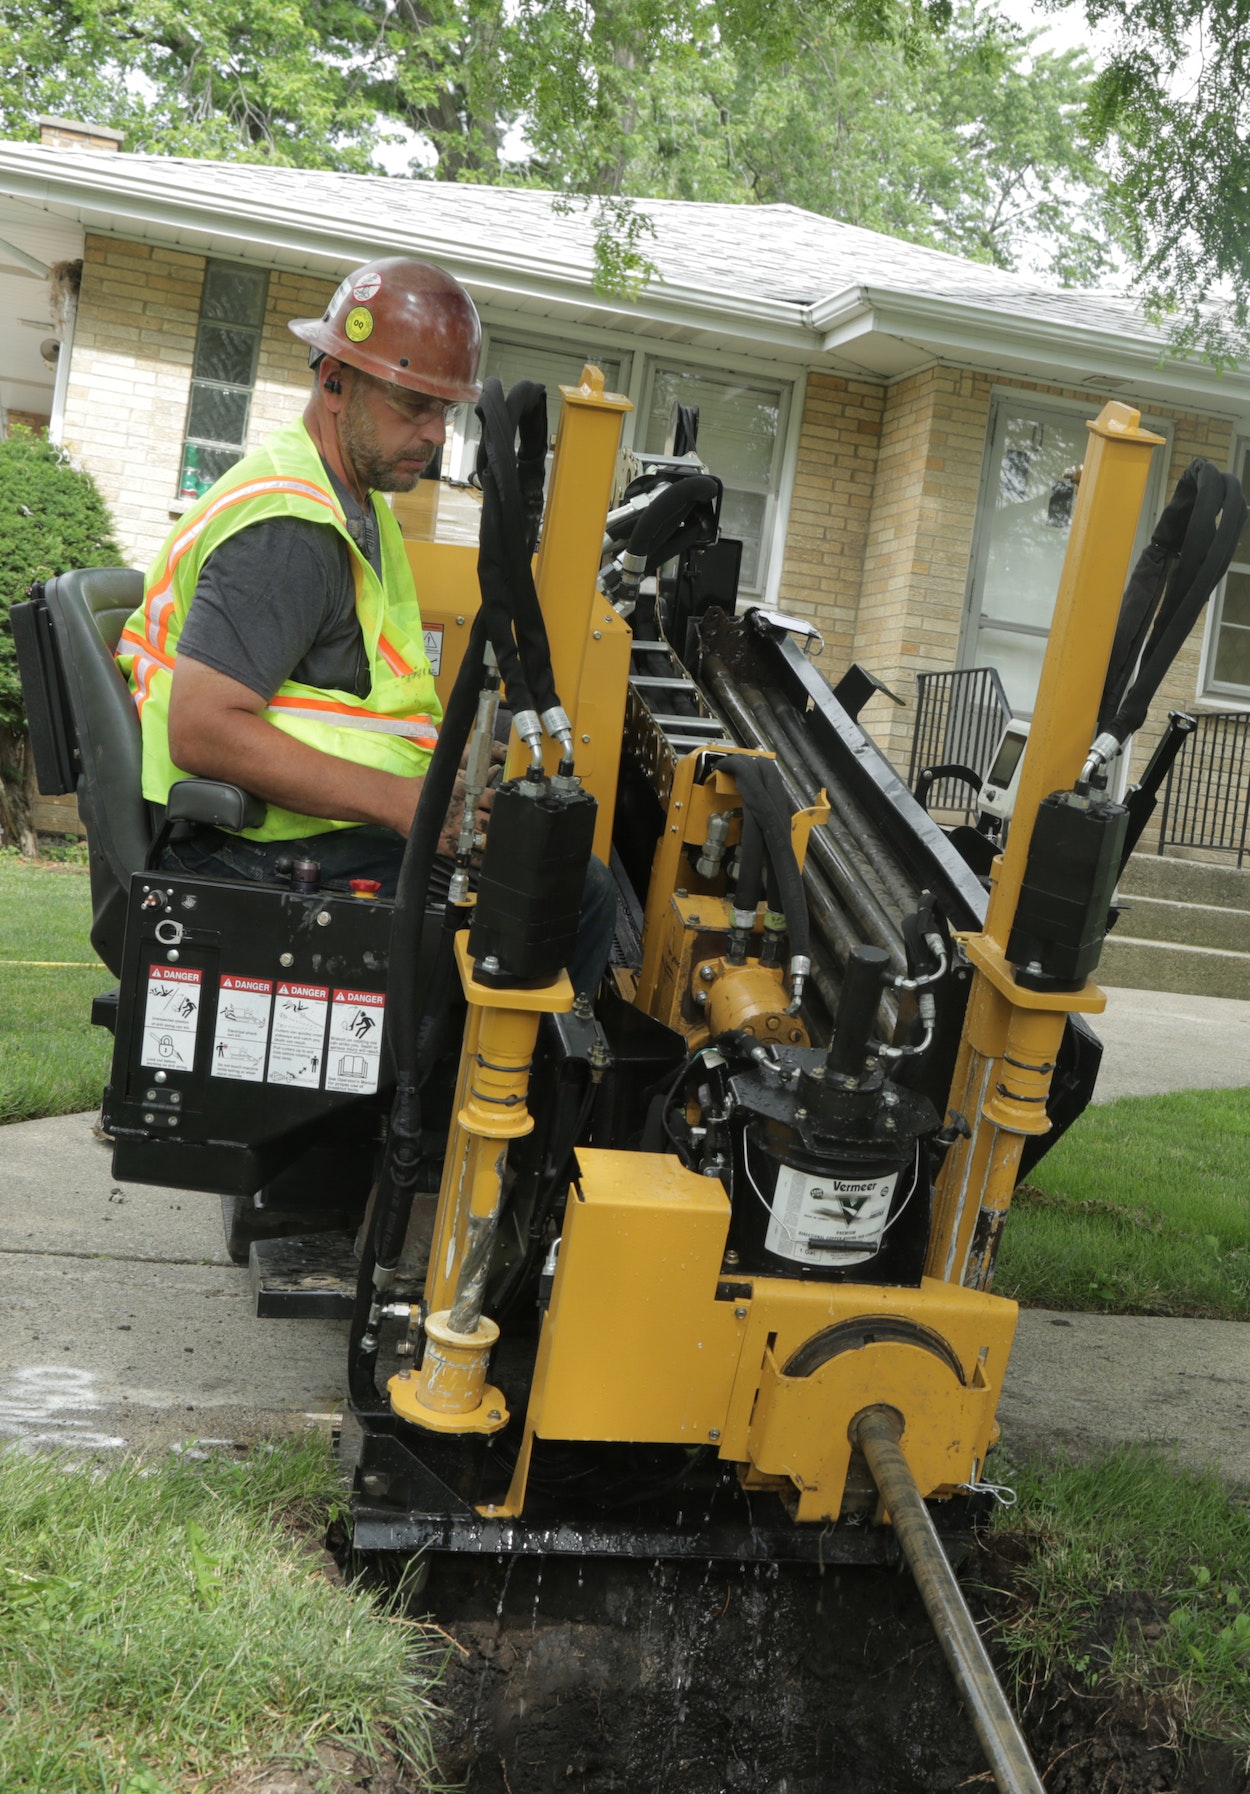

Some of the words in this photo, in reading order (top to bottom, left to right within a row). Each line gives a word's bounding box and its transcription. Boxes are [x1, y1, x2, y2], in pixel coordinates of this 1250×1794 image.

[354, 320, 364, 330] OQ
[164, 970, 199, 982] DANGER
[235, 980, 270, 992] DANGER
[291, 987, 326, 998] DANGER
[348, 993, 382, 1004] DANGER
[833, 1181, 877, 1192] Vermeer
